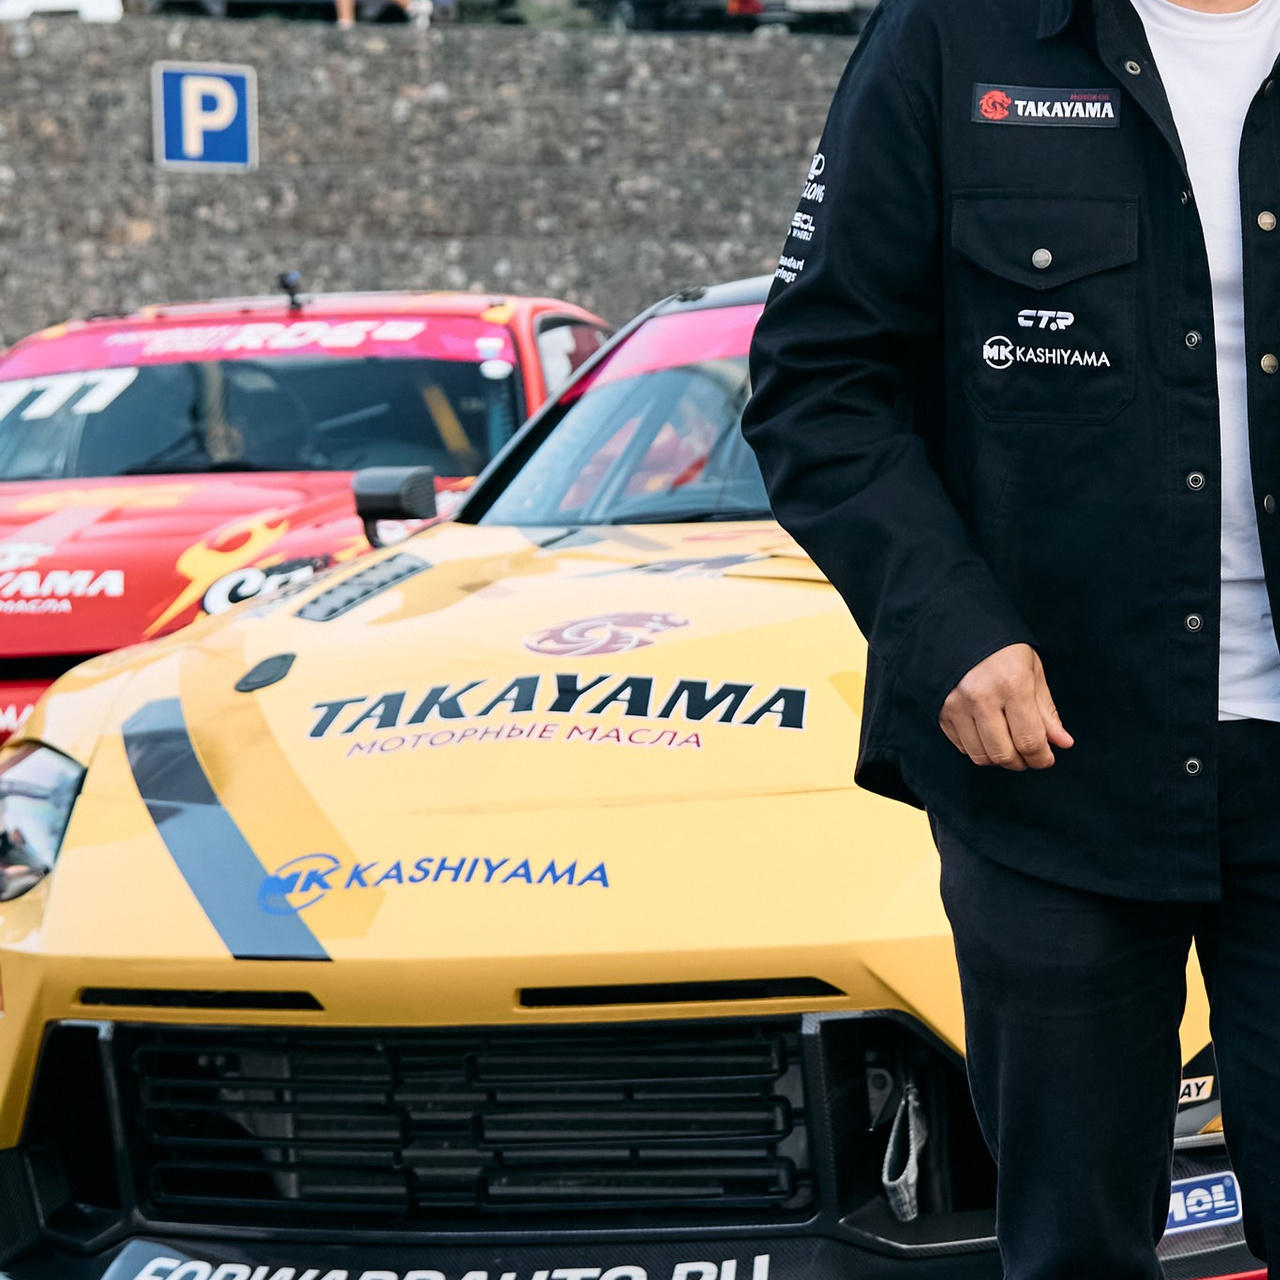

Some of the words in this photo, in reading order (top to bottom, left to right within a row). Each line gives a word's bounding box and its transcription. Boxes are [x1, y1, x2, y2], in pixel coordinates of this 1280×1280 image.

[181, 74, 238, 158] P
[1014, 99, 1114, 119] TAKAYAMA
[1016, 346, 1111, 367] KASHIYAMA
[309, 673, 809, 739] TAKAYAMA
[346, 723, 556, 757] МОТОРНЫЕ
[566, 724, 702, 749] МАСЛА
[343, 856, 610, 889] KASHIYAMA
